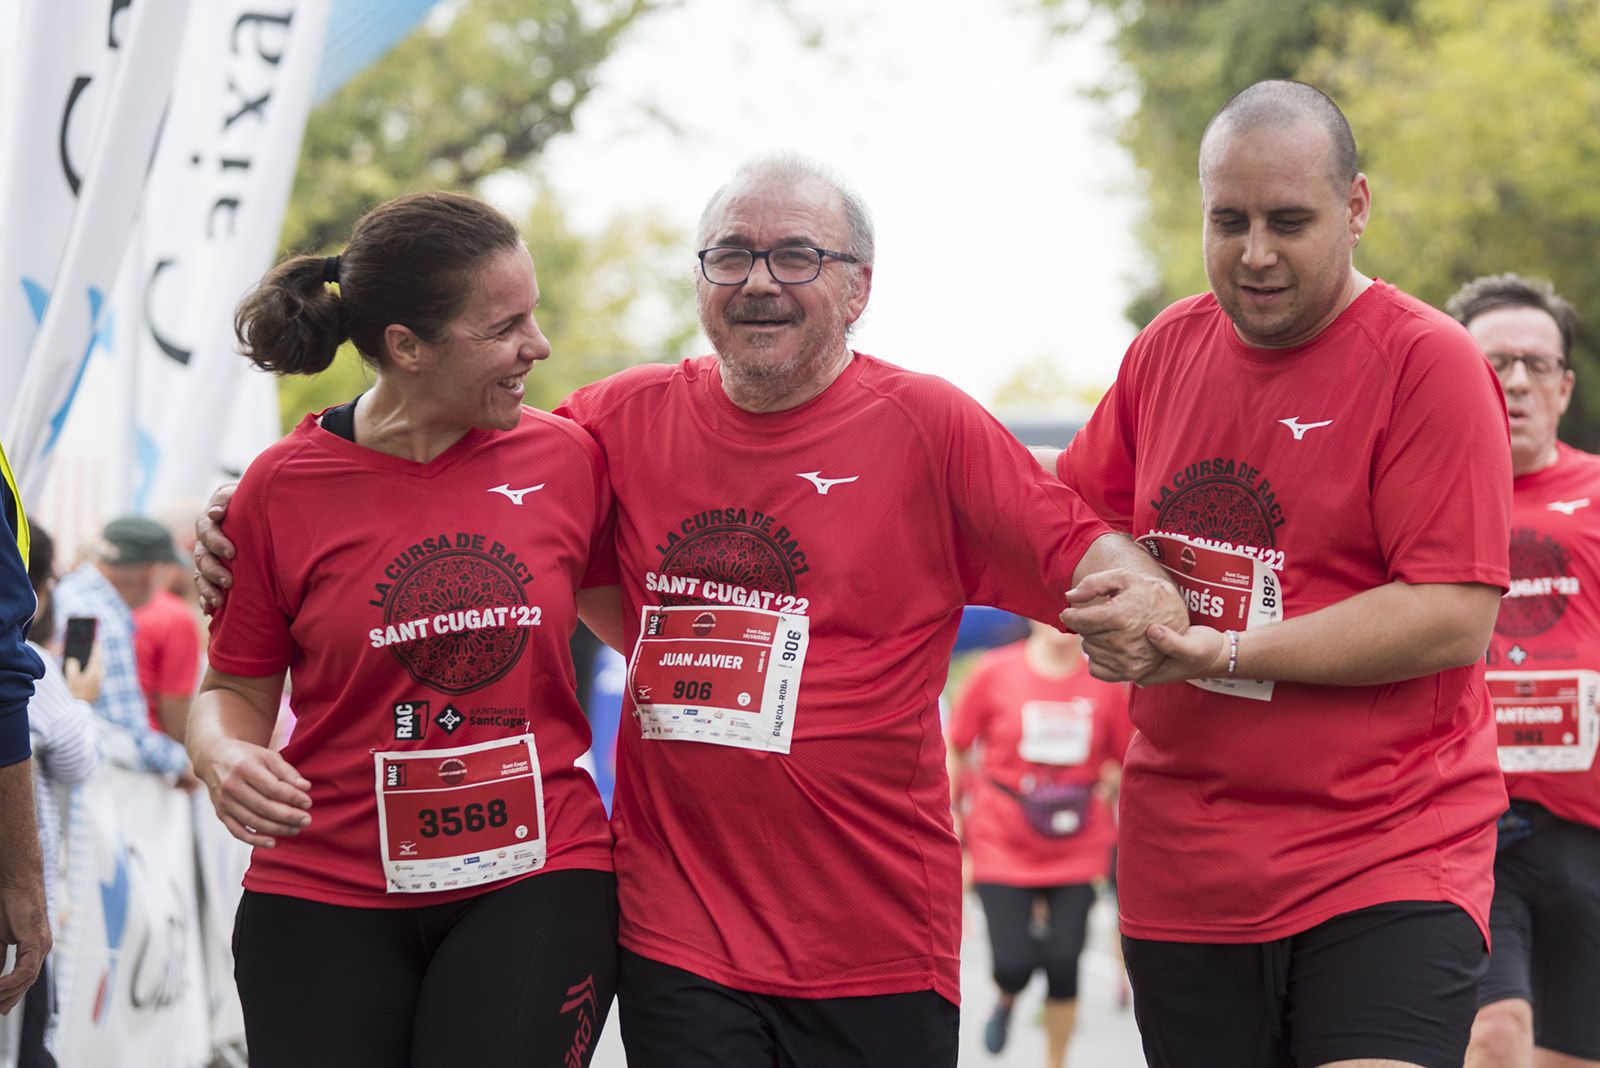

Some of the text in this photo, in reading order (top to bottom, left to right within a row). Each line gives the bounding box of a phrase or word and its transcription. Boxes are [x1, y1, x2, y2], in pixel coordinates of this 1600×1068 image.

[1150, 457, 1286, 528] LA CURSA DE RAC1
[656, 531, 681, 556] LA
[680, 507, 747, 535] CURSA
[751, 511, 776, 532] DE
[368, 533, 535, 608] LA CURSA DE RAC1
[1510, 577, 1551, 597] UGAT
[646, 571, 700, 595] SANT
[702, 581, 775, 610] CUGAT
[1262, 575, 1276, 608] 892
[368, 618, 429, 648] SANT
[433, 607, 508, 635] CUGAT
[782, 630, 801, 662] 906
[659, 653, 695, 667] JUAN
[694, 653, 744, 670] JAVIER
[673, 680, 713, 700] 906
[772, 679, 789, 737] GUARDA-ROBA
[418, 798, 508, 838] 3568
